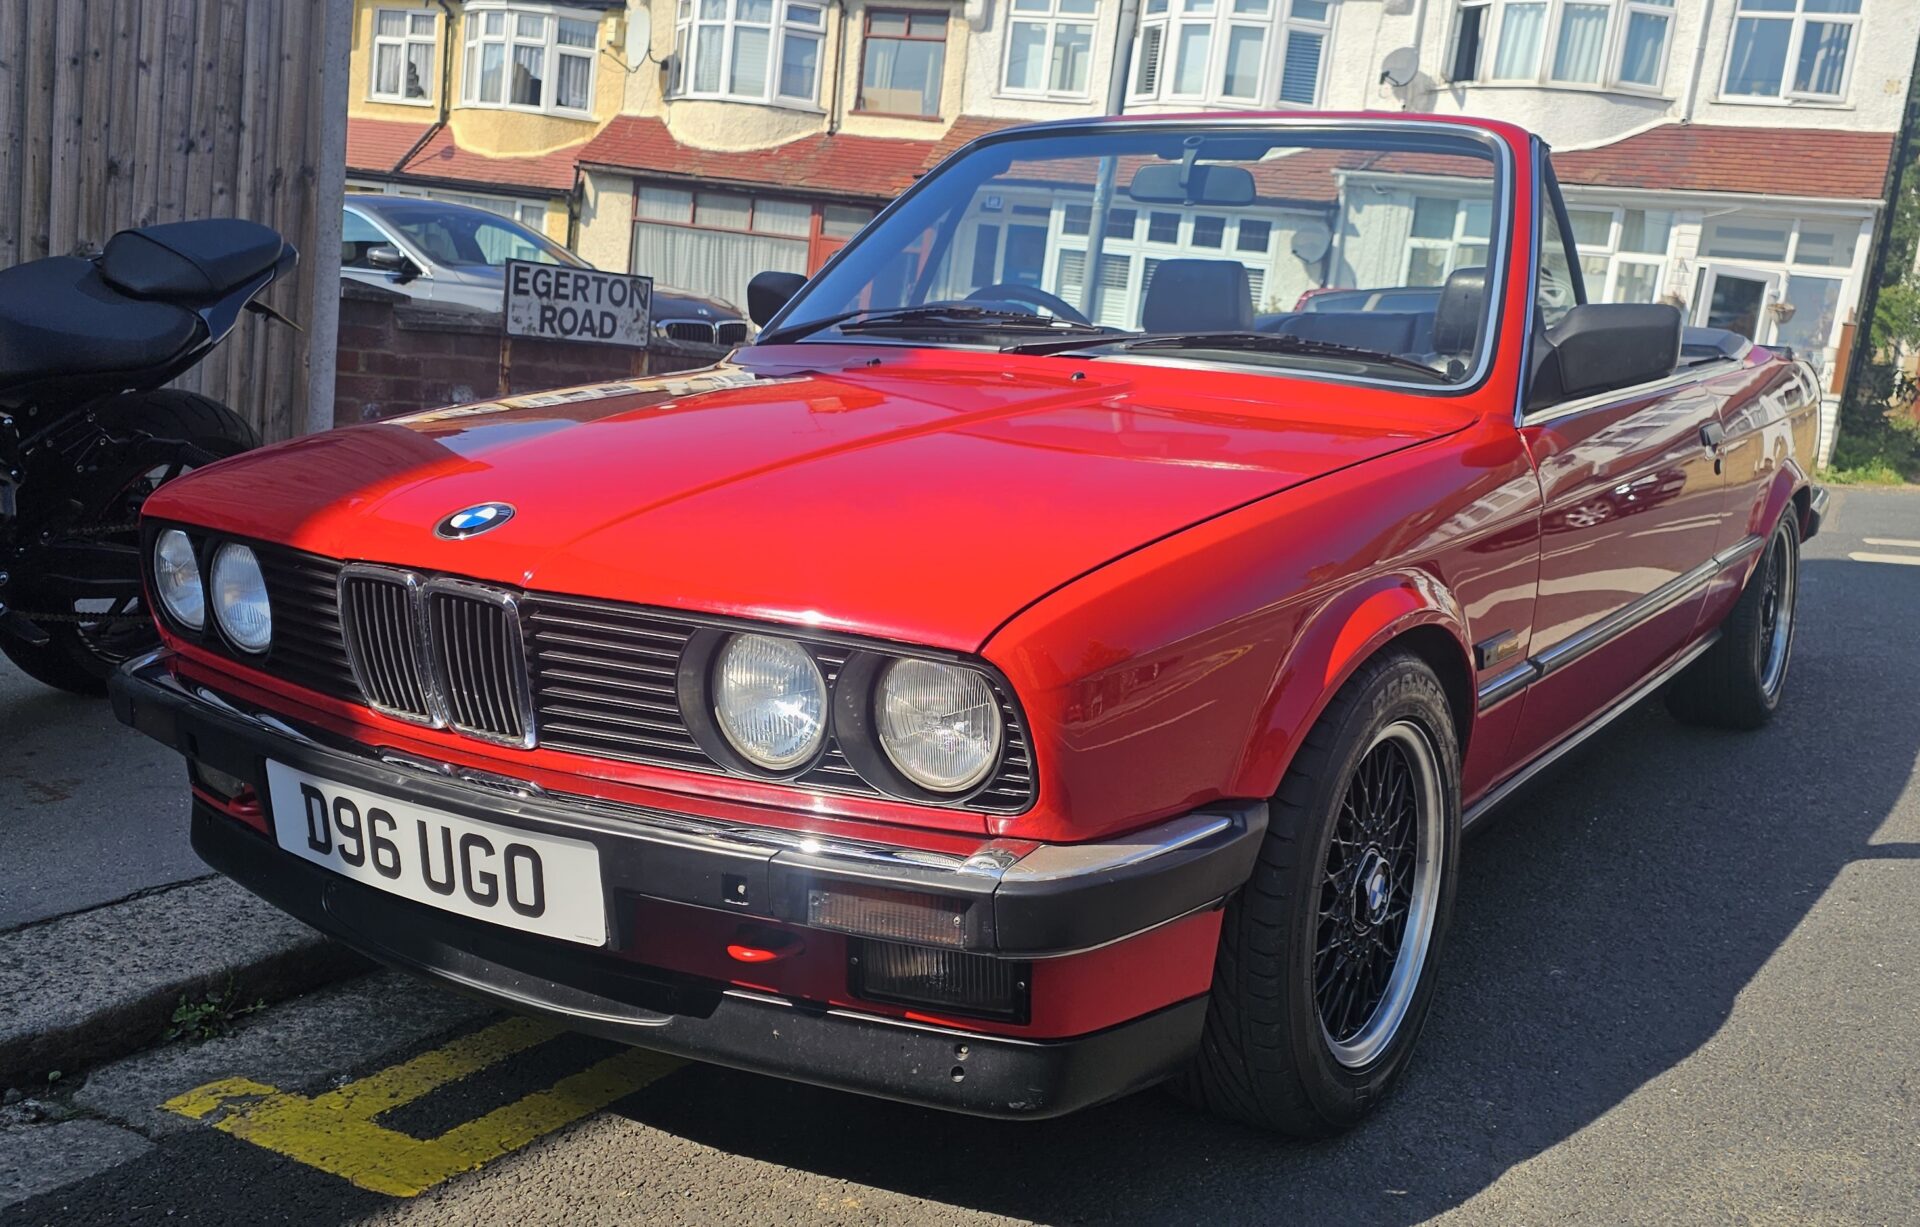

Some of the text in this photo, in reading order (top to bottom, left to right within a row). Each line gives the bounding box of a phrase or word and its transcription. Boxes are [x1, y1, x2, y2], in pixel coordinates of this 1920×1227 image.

[513, 266, 649, 310] EGERTON
[539, 305, 617, 339] ROAD
[300, 782, 546, 919] D96 UGO
